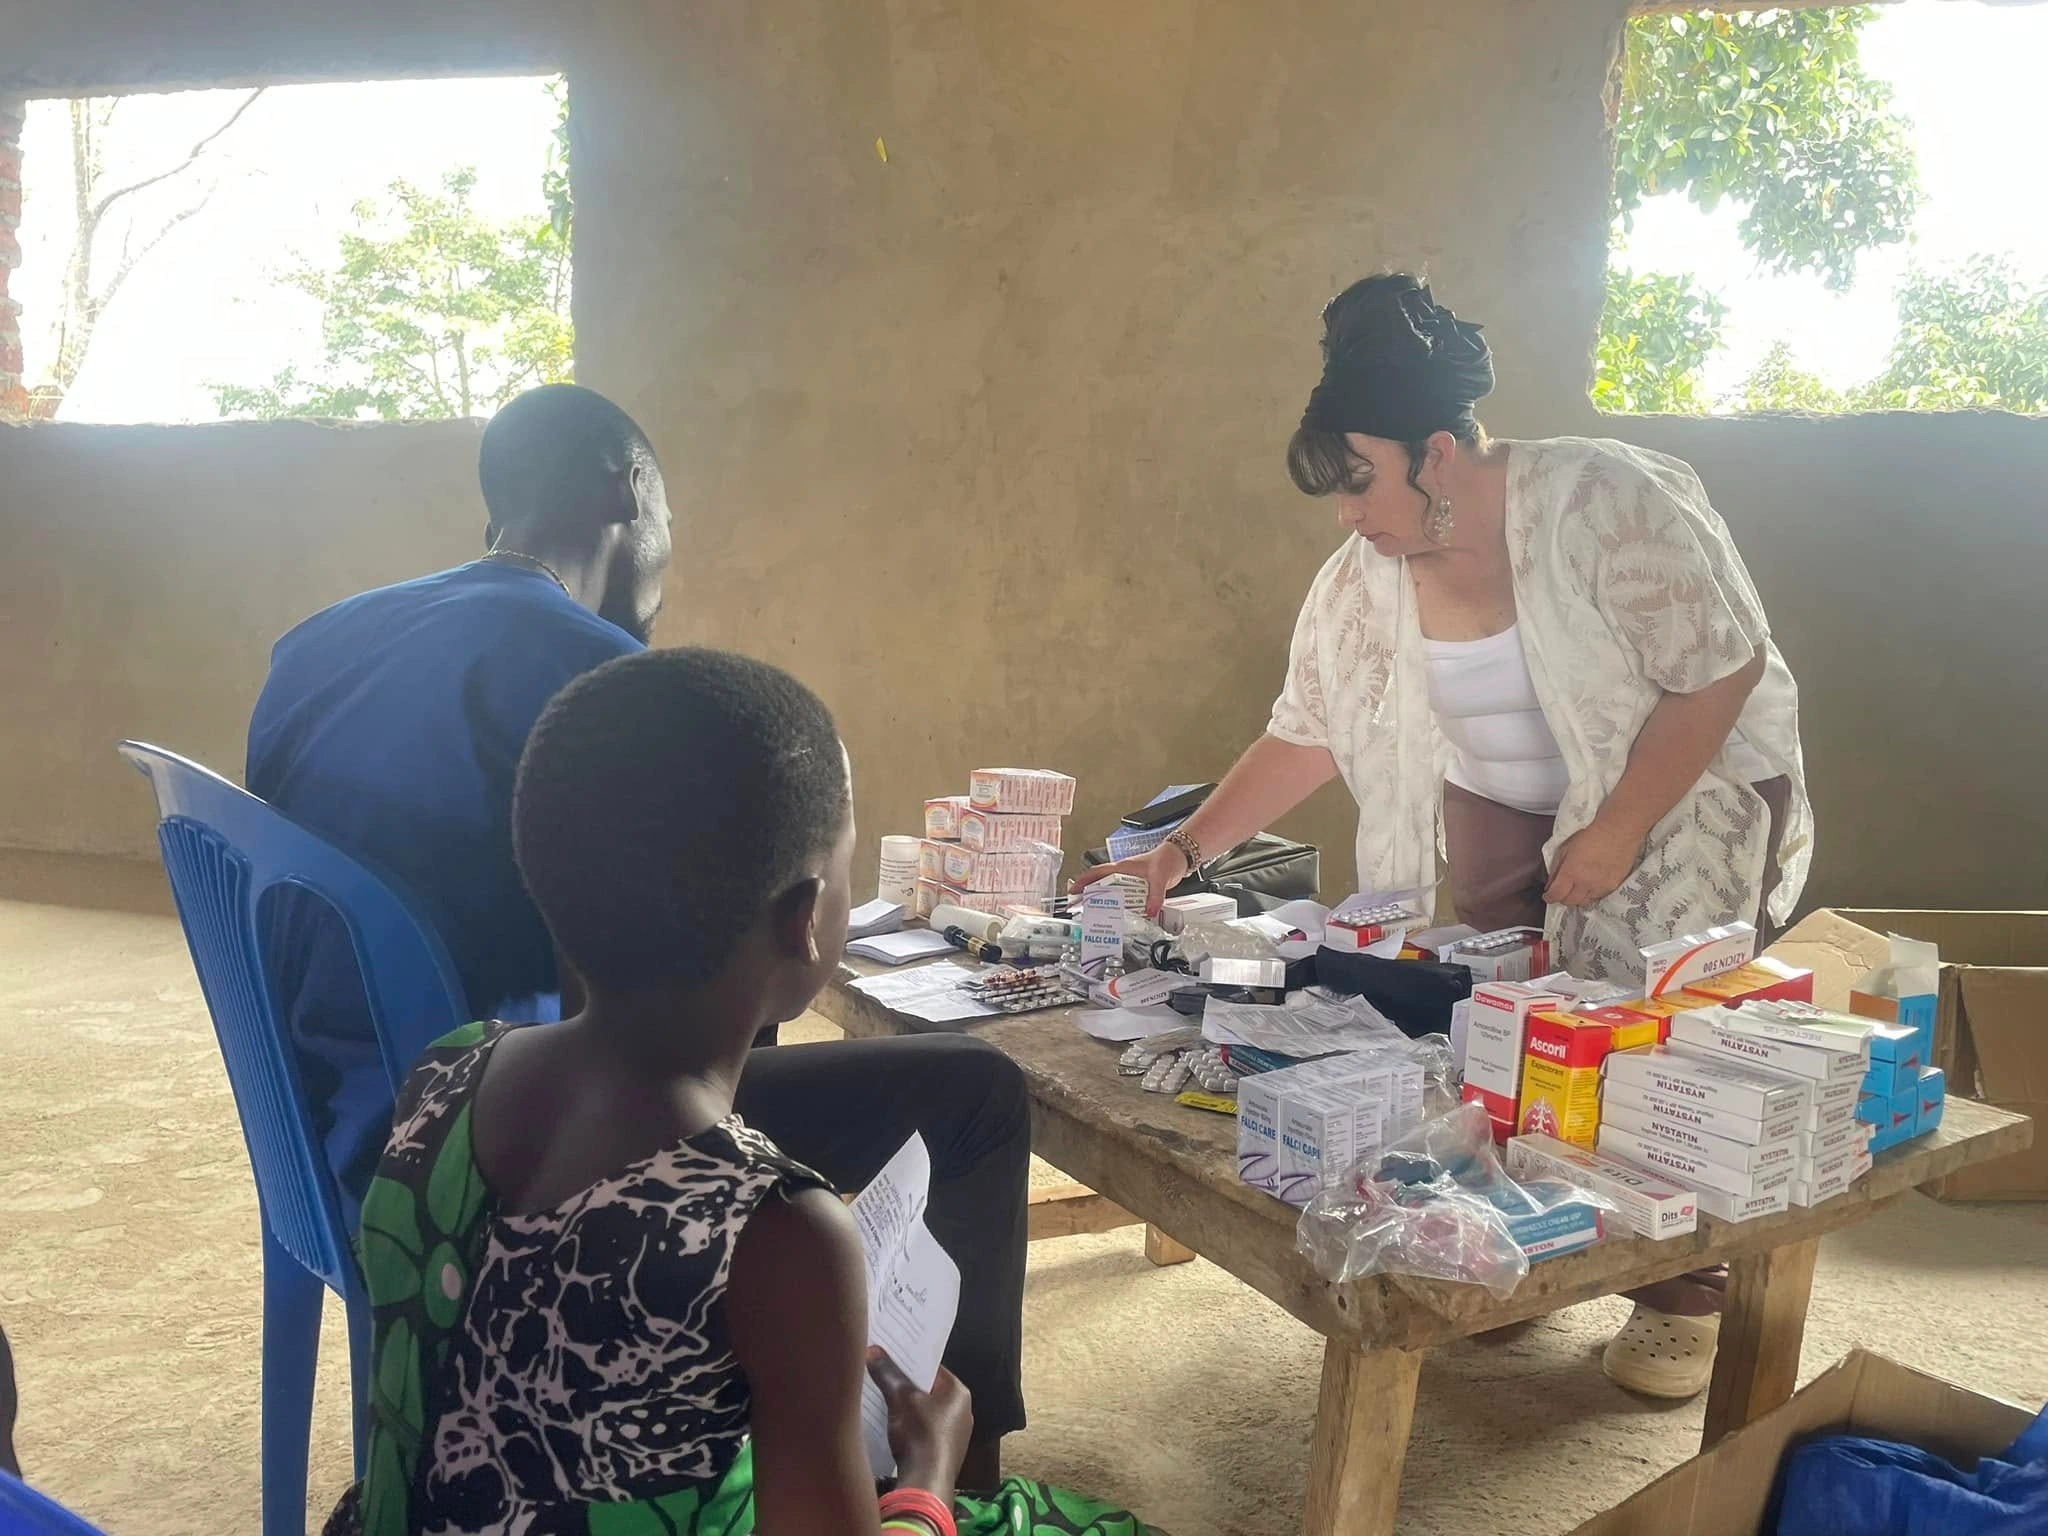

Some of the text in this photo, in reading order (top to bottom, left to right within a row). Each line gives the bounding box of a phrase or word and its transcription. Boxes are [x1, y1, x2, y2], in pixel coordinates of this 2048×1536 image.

[1084, 935, 1120, 945] FALCI CARE
[1703, 951, 1746, 973] AZICIN 500
[1530, 1036, 1566, 1059] Ascoril
[1720, 1038, 1769, 1059] NYSTATIN
[1656, 1079, 1706, 1099] NYSTATIN
[1653, 1103, 1702, 1124] NYSTATIN
[1241, 1115, 1276, 1140] FALCI CARE
[1652, 1122, 1698, 1143] NYSTATIN
[1282, 1134, 1302, 1152] FALCI
[1647, 1151, 1695, 1173] NYSTATIN
[1661, 1211, 1678, 1222] Dits
[1523, 1241, 1554, 1255] ISTON
